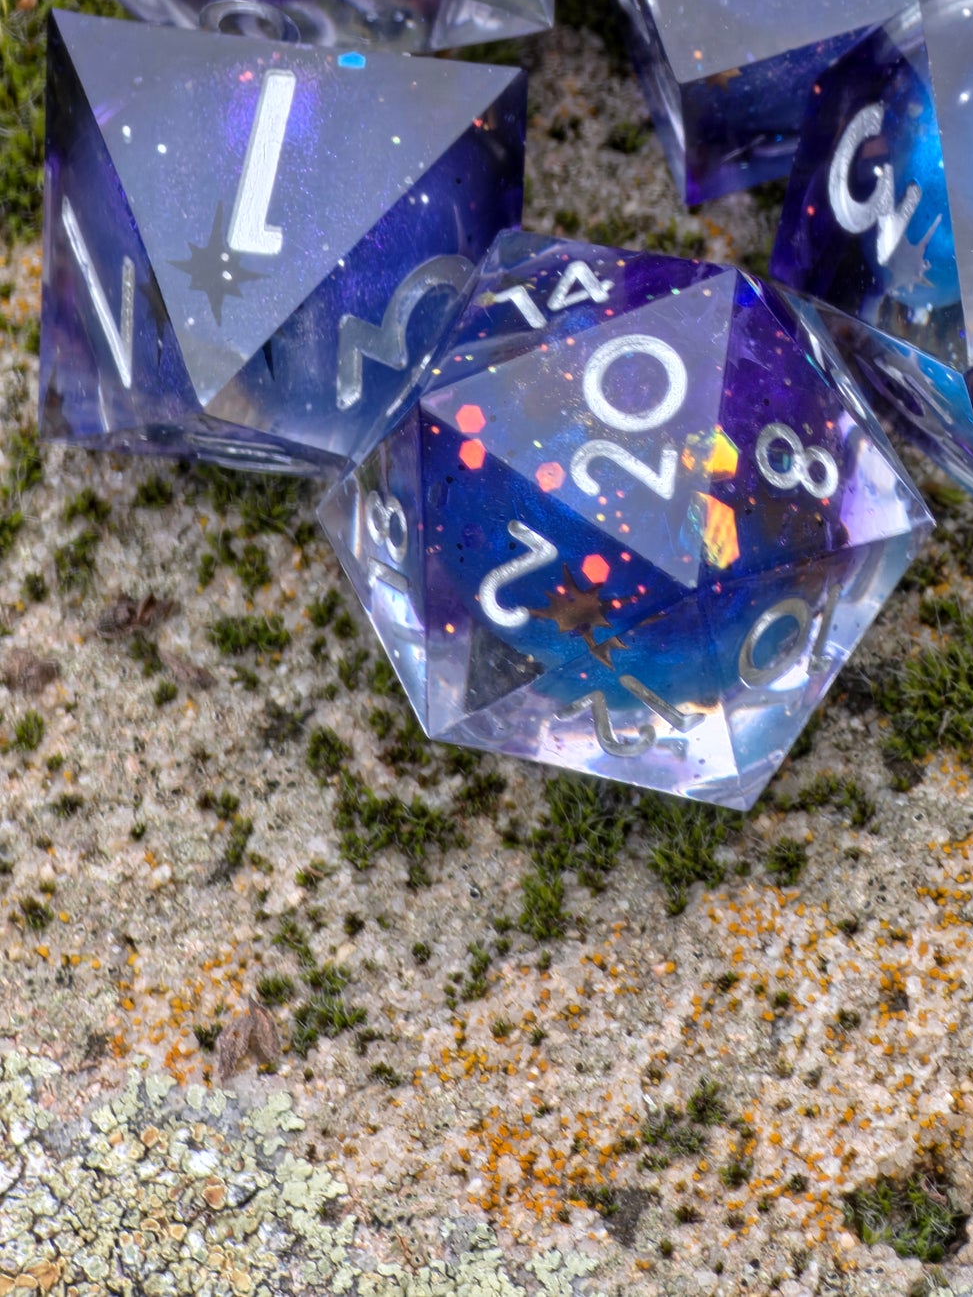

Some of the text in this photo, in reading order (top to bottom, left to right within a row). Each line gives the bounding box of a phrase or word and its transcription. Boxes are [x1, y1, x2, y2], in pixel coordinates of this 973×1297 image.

[228, 68, 297, 255] 1
[492, 260, 614, 329] 14
[570, 334, 688, 499] 20
[755, 423, 839, 499] 8
[366, 489, 410, 595] 18
[478, 519, 558, 628] 2
